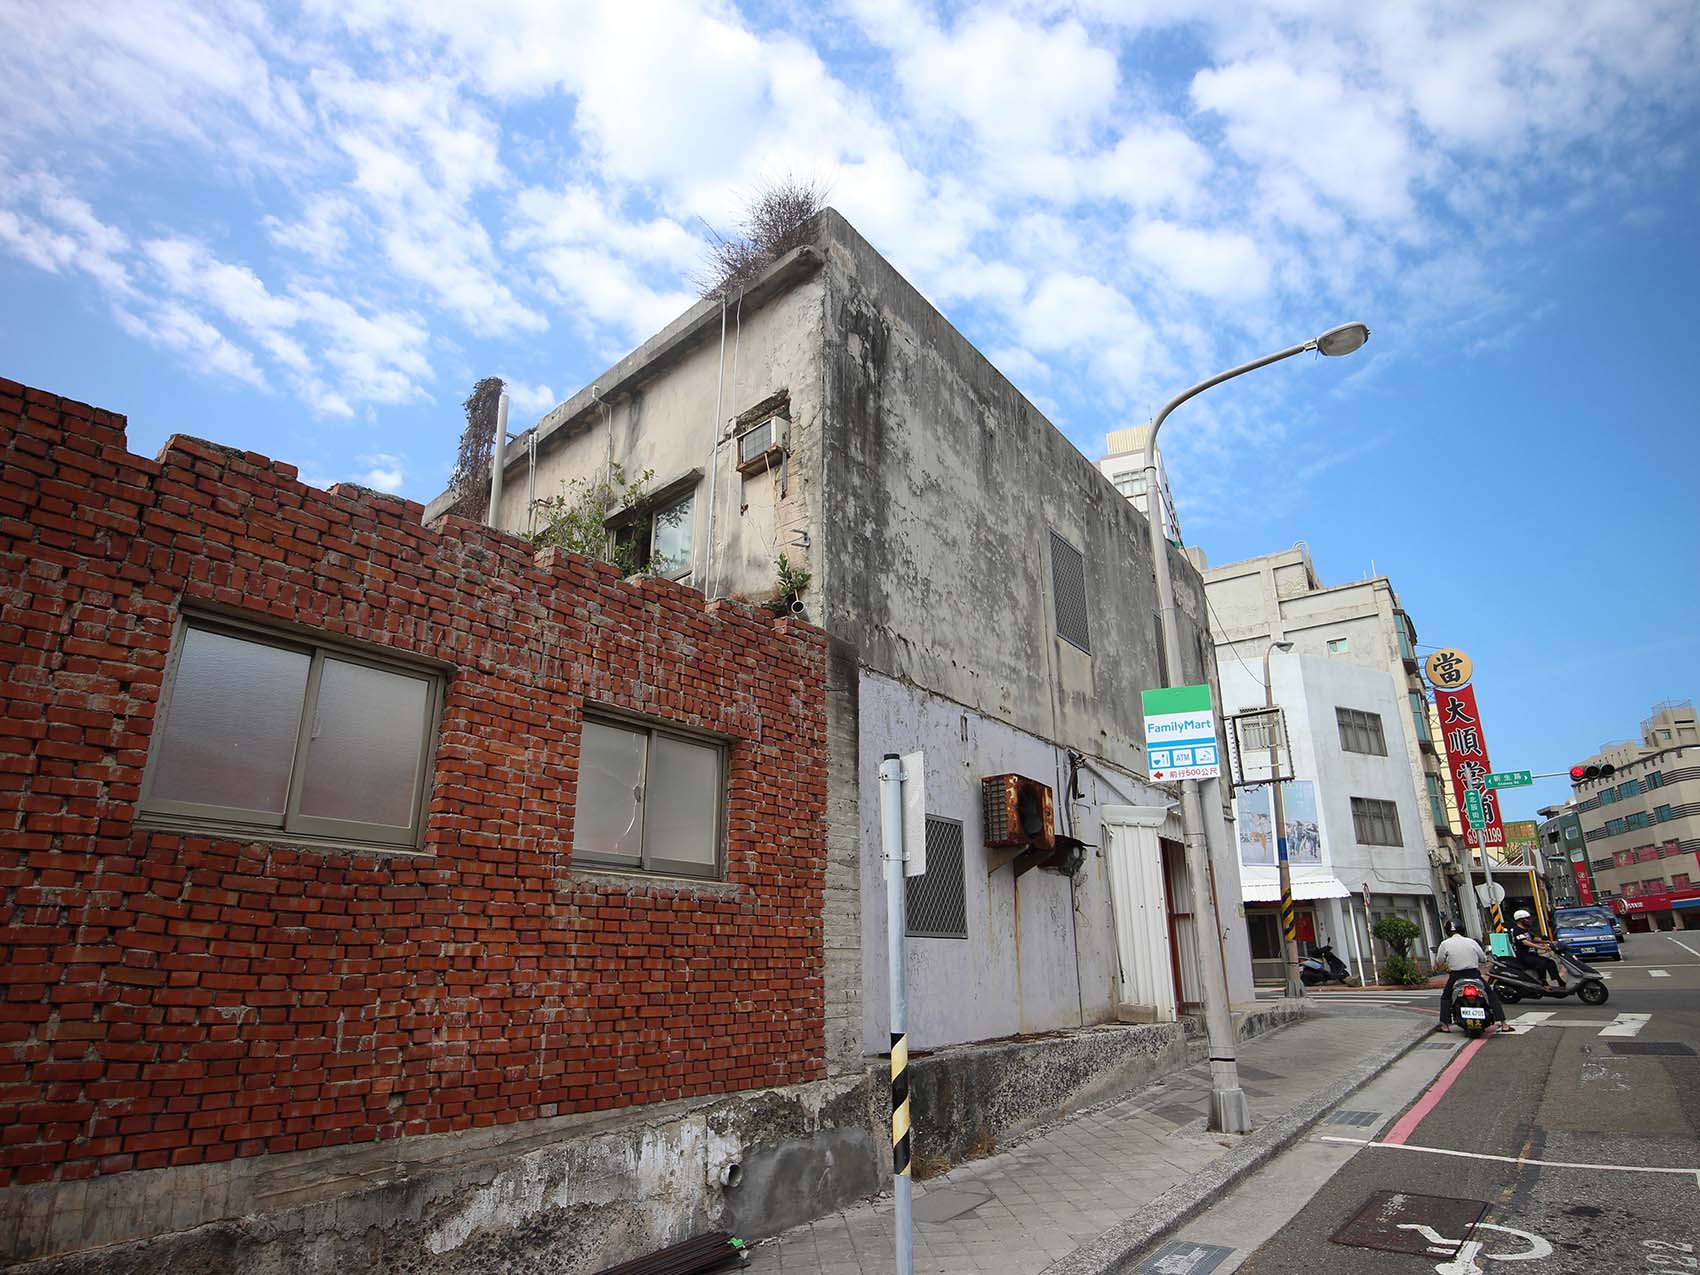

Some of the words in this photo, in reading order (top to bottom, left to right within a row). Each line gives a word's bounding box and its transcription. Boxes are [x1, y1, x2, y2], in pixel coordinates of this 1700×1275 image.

[1432, 652, 1463, 684] 當
[1148, 719, 1211, 733] FamilyMart
[1176, 753, 1189, 761] ATM
[1170, 767, 1218, 778] 前行500公尺
